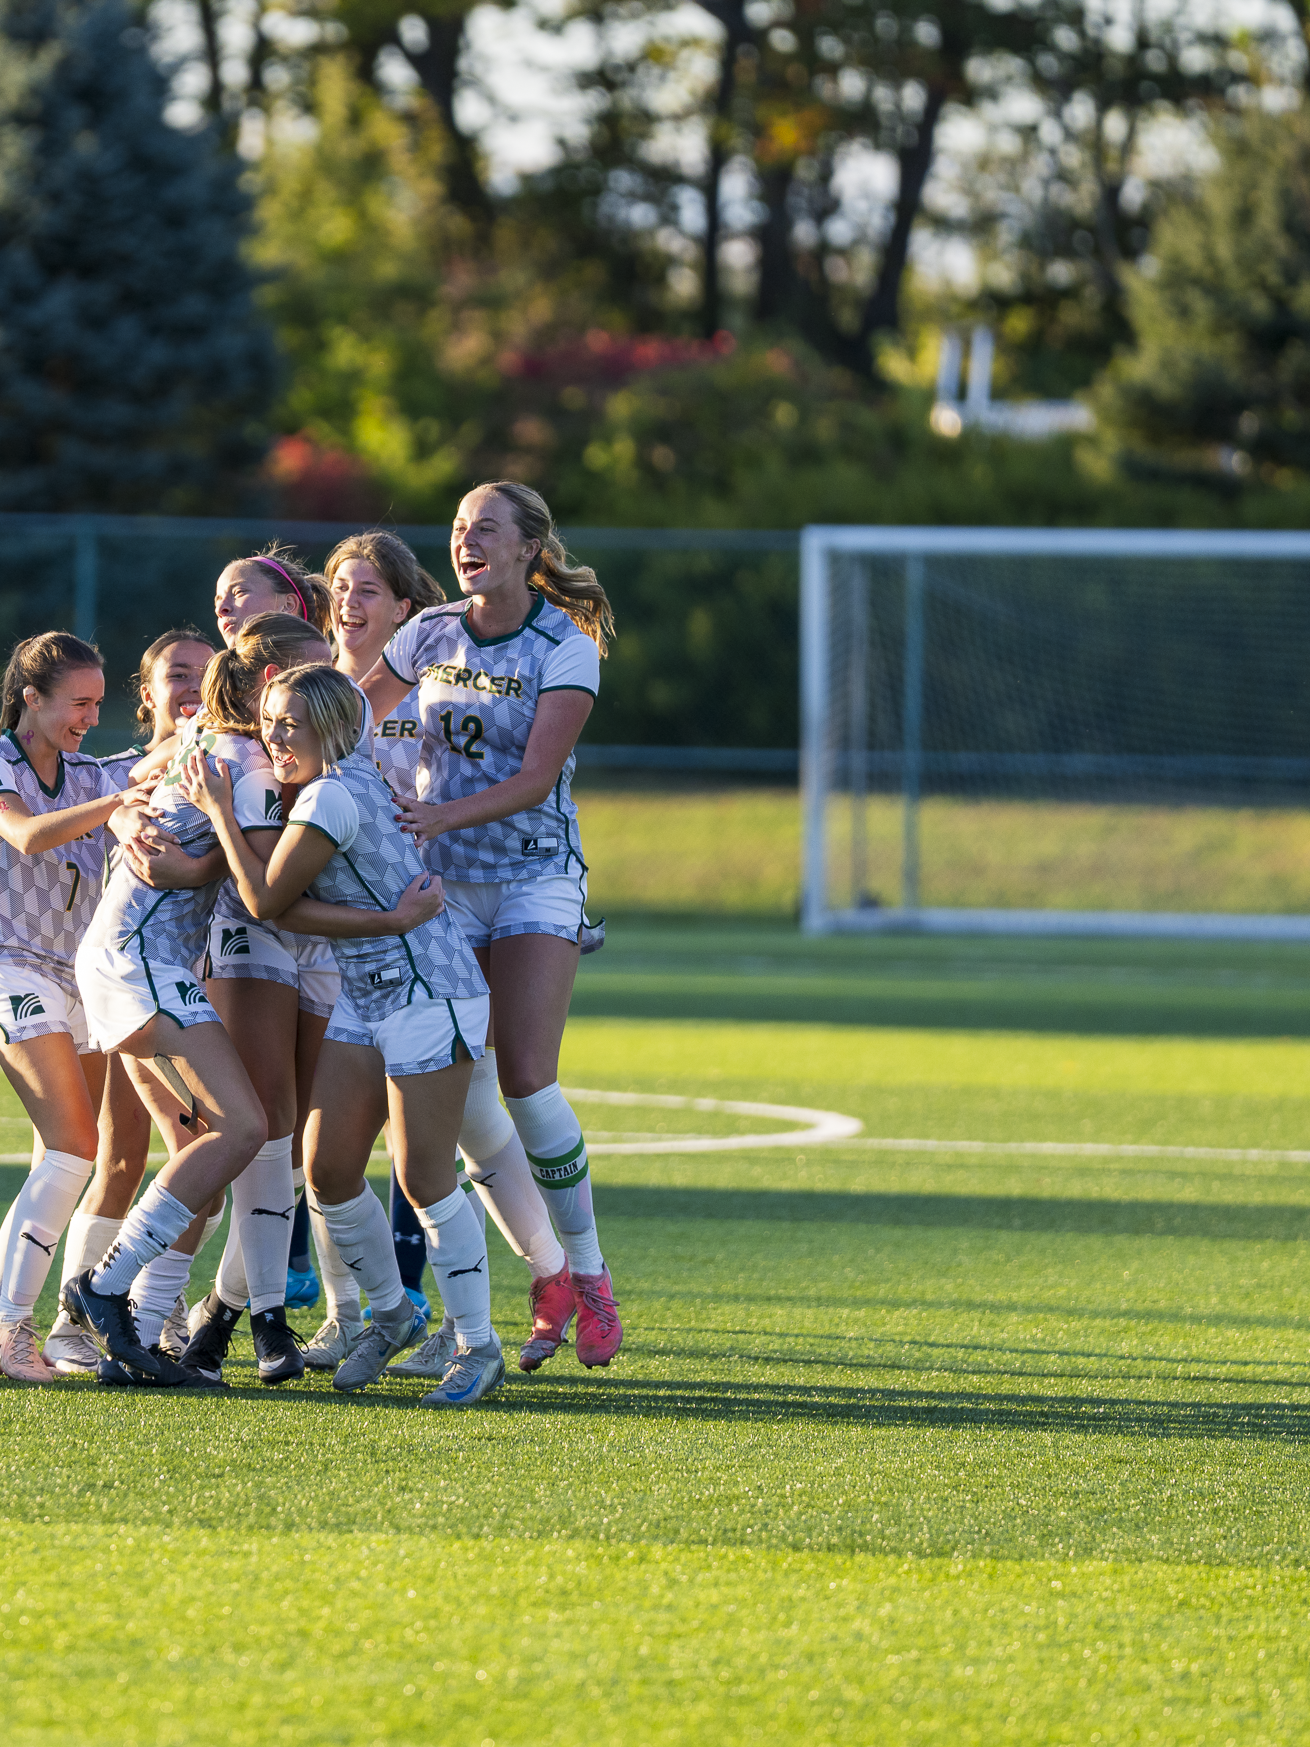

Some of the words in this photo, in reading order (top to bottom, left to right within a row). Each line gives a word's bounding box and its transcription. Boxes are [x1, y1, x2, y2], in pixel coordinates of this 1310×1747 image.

[427, 662, 523, 699] MERCER
[440, 709, 485, 760] 12
[65, 860, 81, 912] 7
[539, 1160, 579, 1180] CAPTAIN
